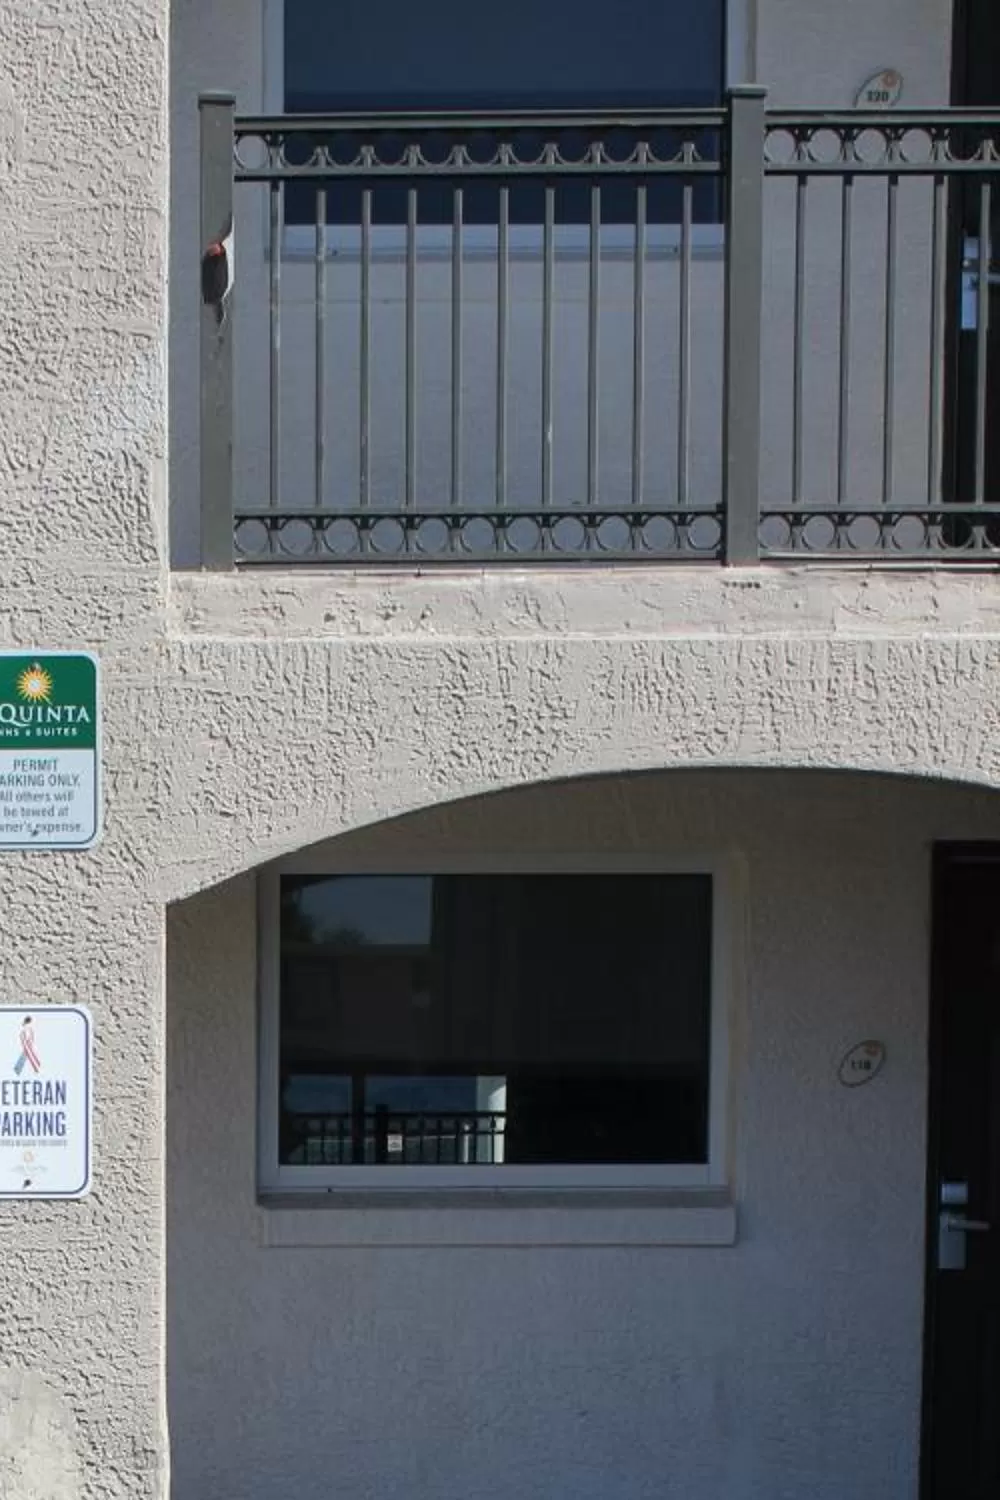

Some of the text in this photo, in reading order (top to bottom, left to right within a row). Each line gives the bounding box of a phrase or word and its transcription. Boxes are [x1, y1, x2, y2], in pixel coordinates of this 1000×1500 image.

[36, 727, 78, 737] SUITES
[13, 758, 58, 772] PERMIT
[0, 790, 75, 802] All others will
[3, 805, 70, 817] be towed at
